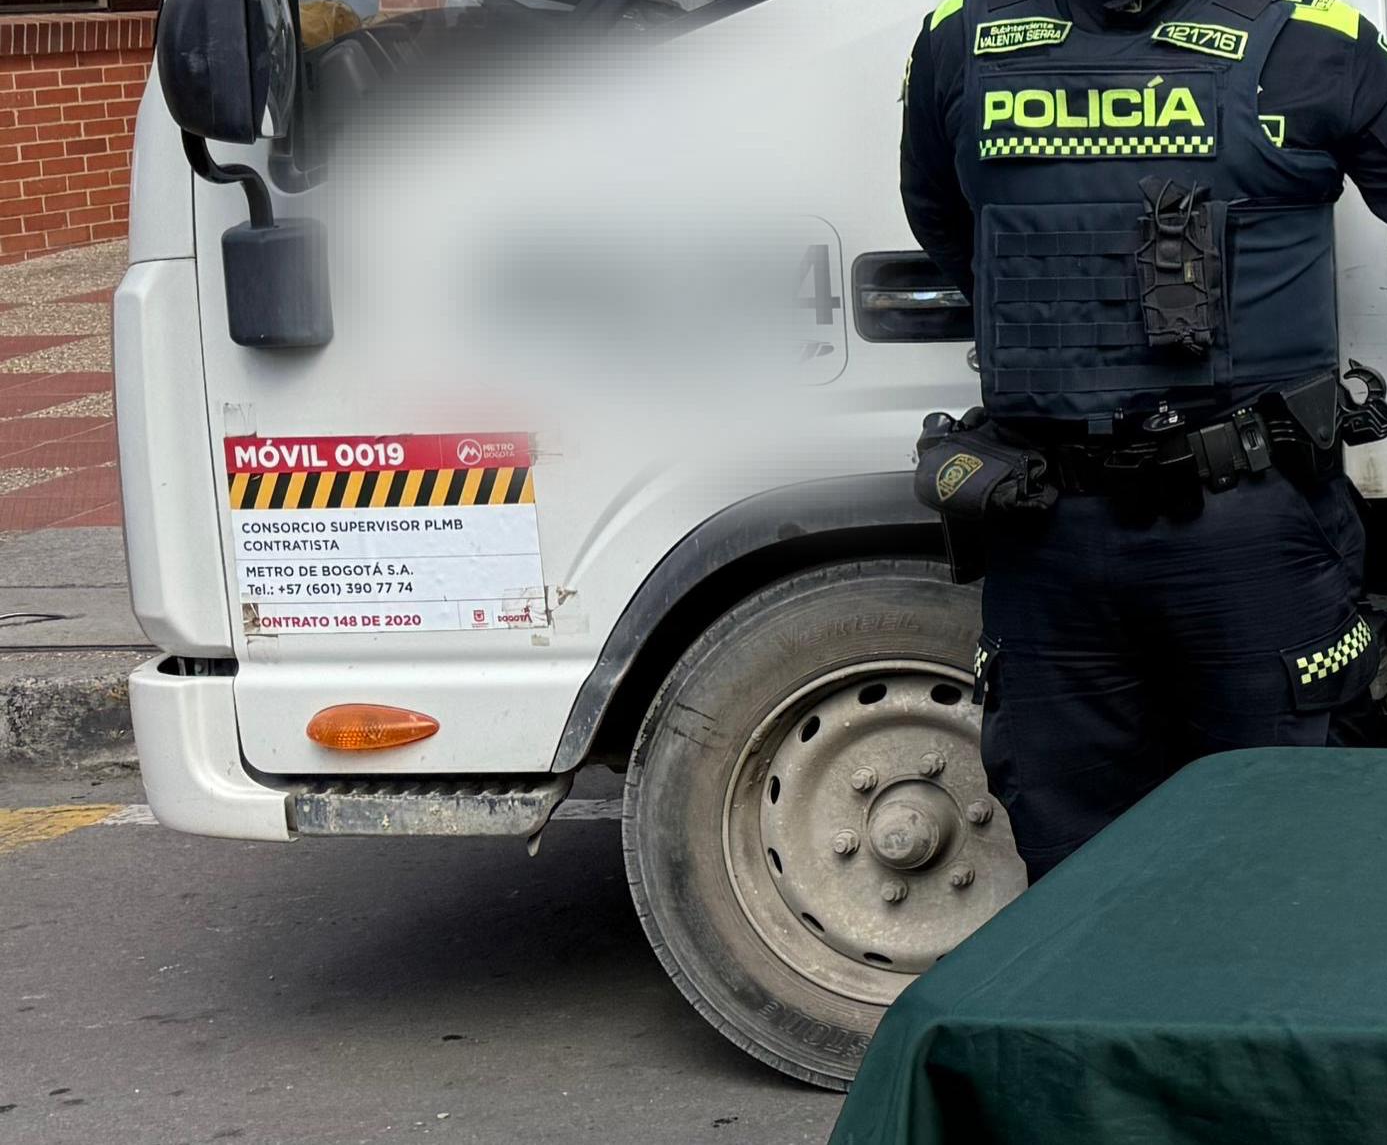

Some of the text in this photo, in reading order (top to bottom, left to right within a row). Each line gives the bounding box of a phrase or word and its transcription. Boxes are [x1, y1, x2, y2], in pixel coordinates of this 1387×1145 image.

[1165, 26, 1236, 51] 121716
[983, 75, 1206, 130] POLICÍA
[234, 439, 405, 468] MÓVIL 0019
[242, 519, 464, 534] CONSORCIO SUPERVISOR PLMB
[243, 540, 340, 551] CONTRATISTA
[246, 562, 414, 577] METRO DE BOGOTÁ S.A.
[247, 582, 413, 595] Tel.: +57 (601) 390 77 74
[252, 615, 421, 628] CONTRATO 148 DE 2020
